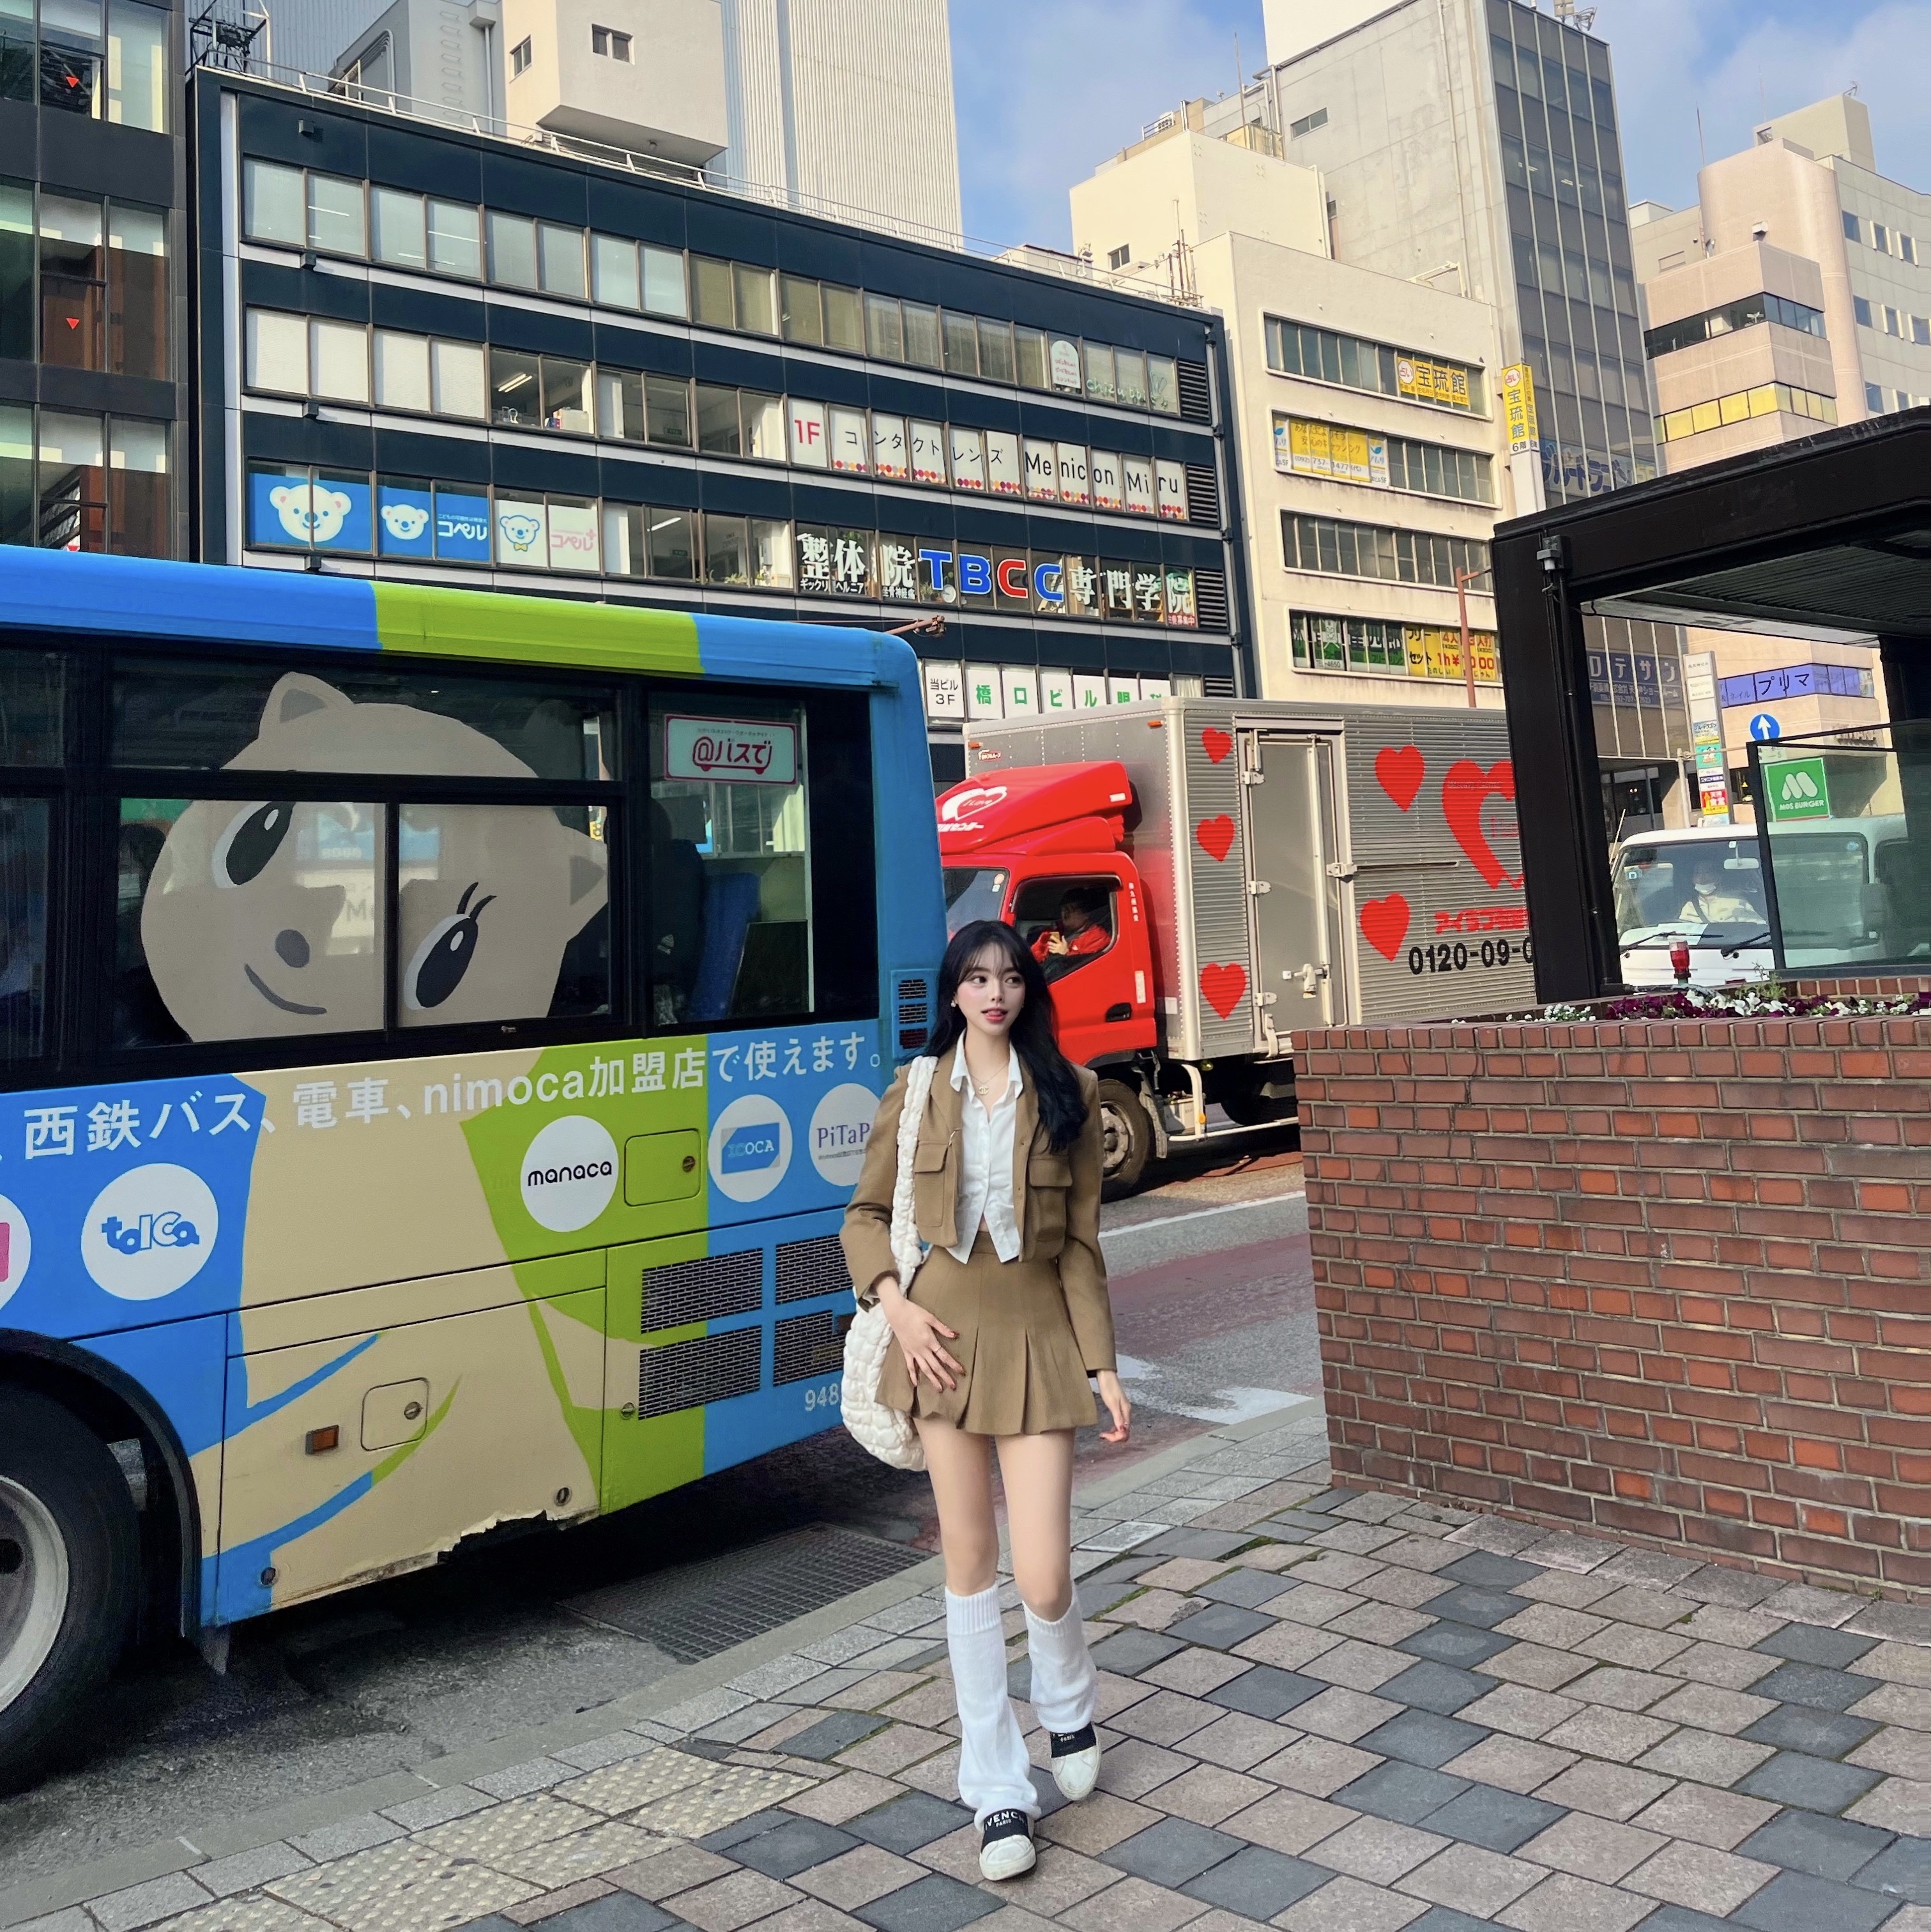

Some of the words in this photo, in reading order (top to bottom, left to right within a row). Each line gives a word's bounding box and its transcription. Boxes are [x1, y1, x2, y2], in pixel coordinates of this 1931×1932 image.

[1416, 364, 1465, 395] 宝琉館
[1507, 389, 1525, 440] 宝琉館
[795, 420, 820, 445] 1F
[845, 431, 1004, 464] コンタクトレンズ
[1127, 471, 1178, 493] Miru
[1512, 441, 1527, 452] 6階
[438, 521, 487, 540] コペル
[801, 535, 914, 588] 整体院
[919, 548, 1064, 602] TBCC
[1069, 566, 1192, 613] 専門学院
[836, 581, 864, 594] ヘルニア
[930, 678, 958, 691] 当ビル
[1759, 673, 1809, 695] プリマ
[936, 694, 956, 705] 3F
[1780, 802, 1794, 811] MOS
[1794, 799, 1824, 809] BURGER
[528, 1160, 613, 1187] manaca
